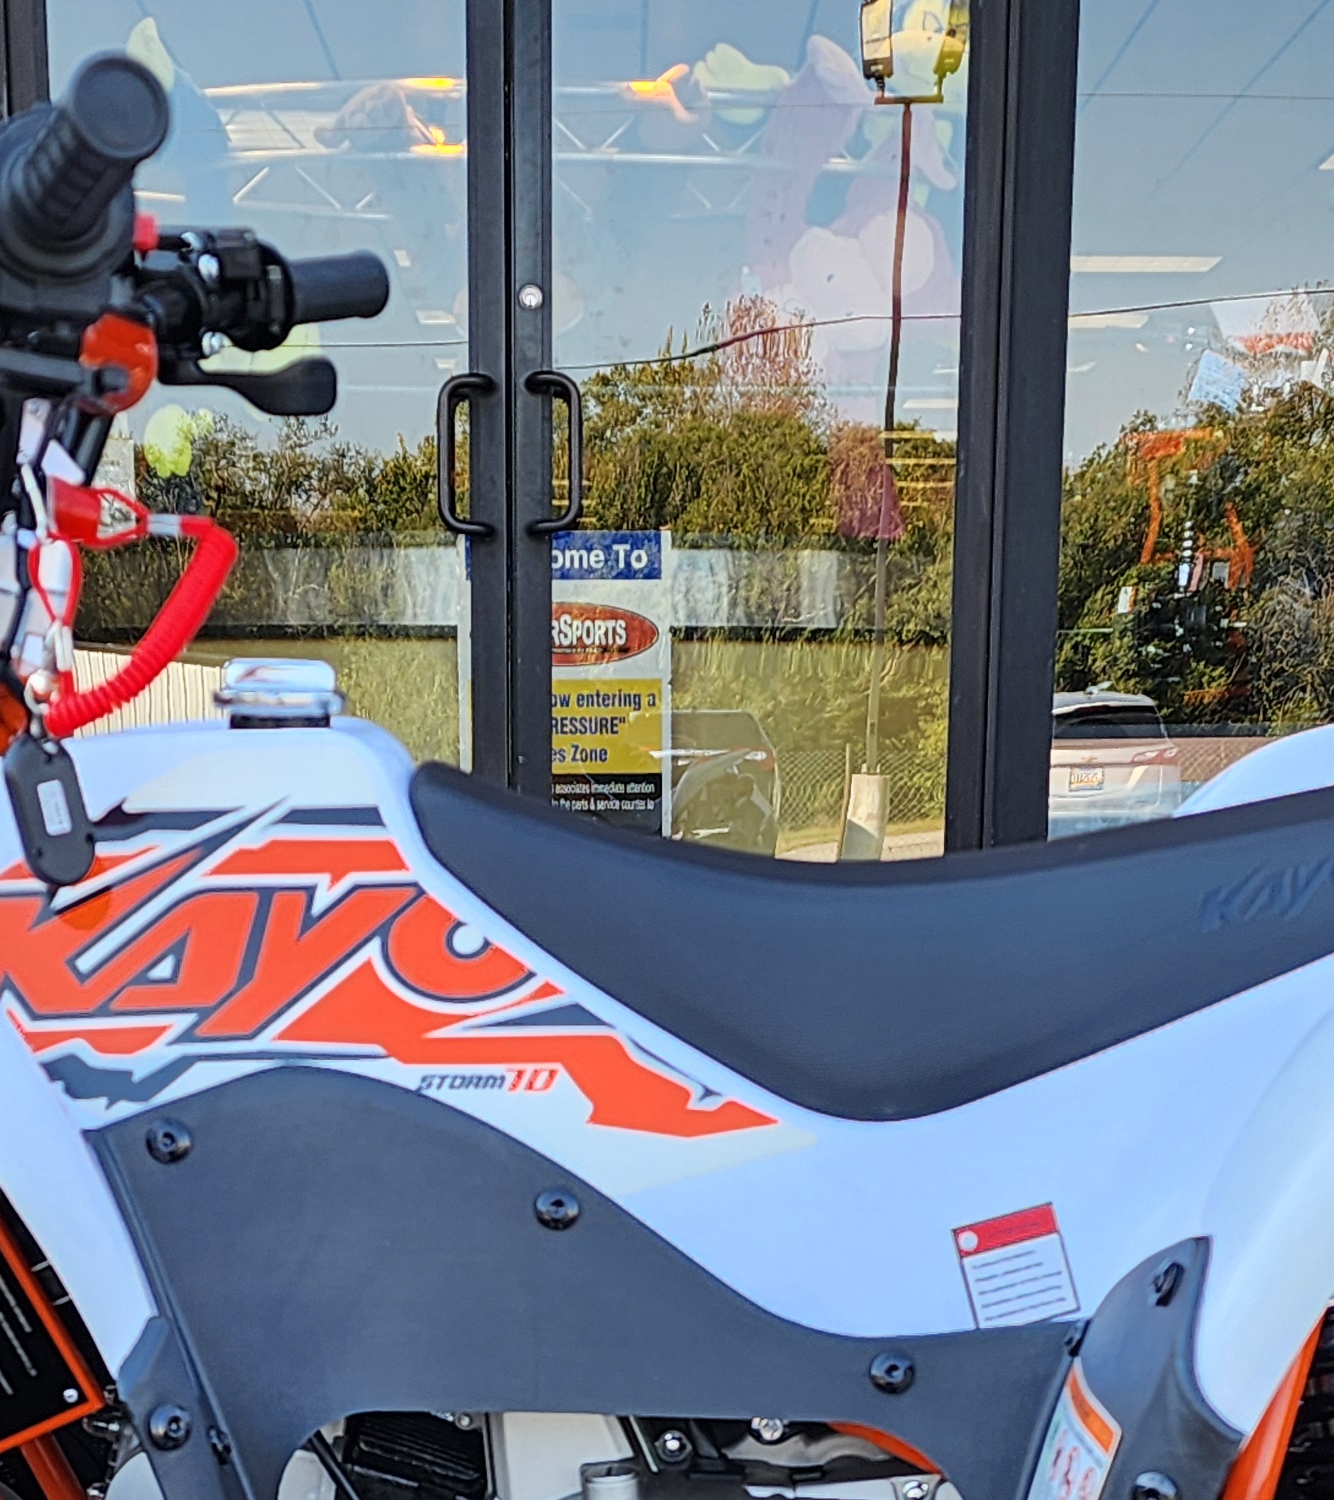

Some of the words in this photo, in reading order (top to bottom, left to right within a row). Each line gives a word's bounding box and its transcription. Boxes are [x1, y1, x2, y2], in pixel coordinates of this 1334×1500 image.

[612, 544, 648, 569] To
[576, 689, 642, 711] entering
[647, 693, 656, 707] a
[571, 744, 608, 763] Zone
